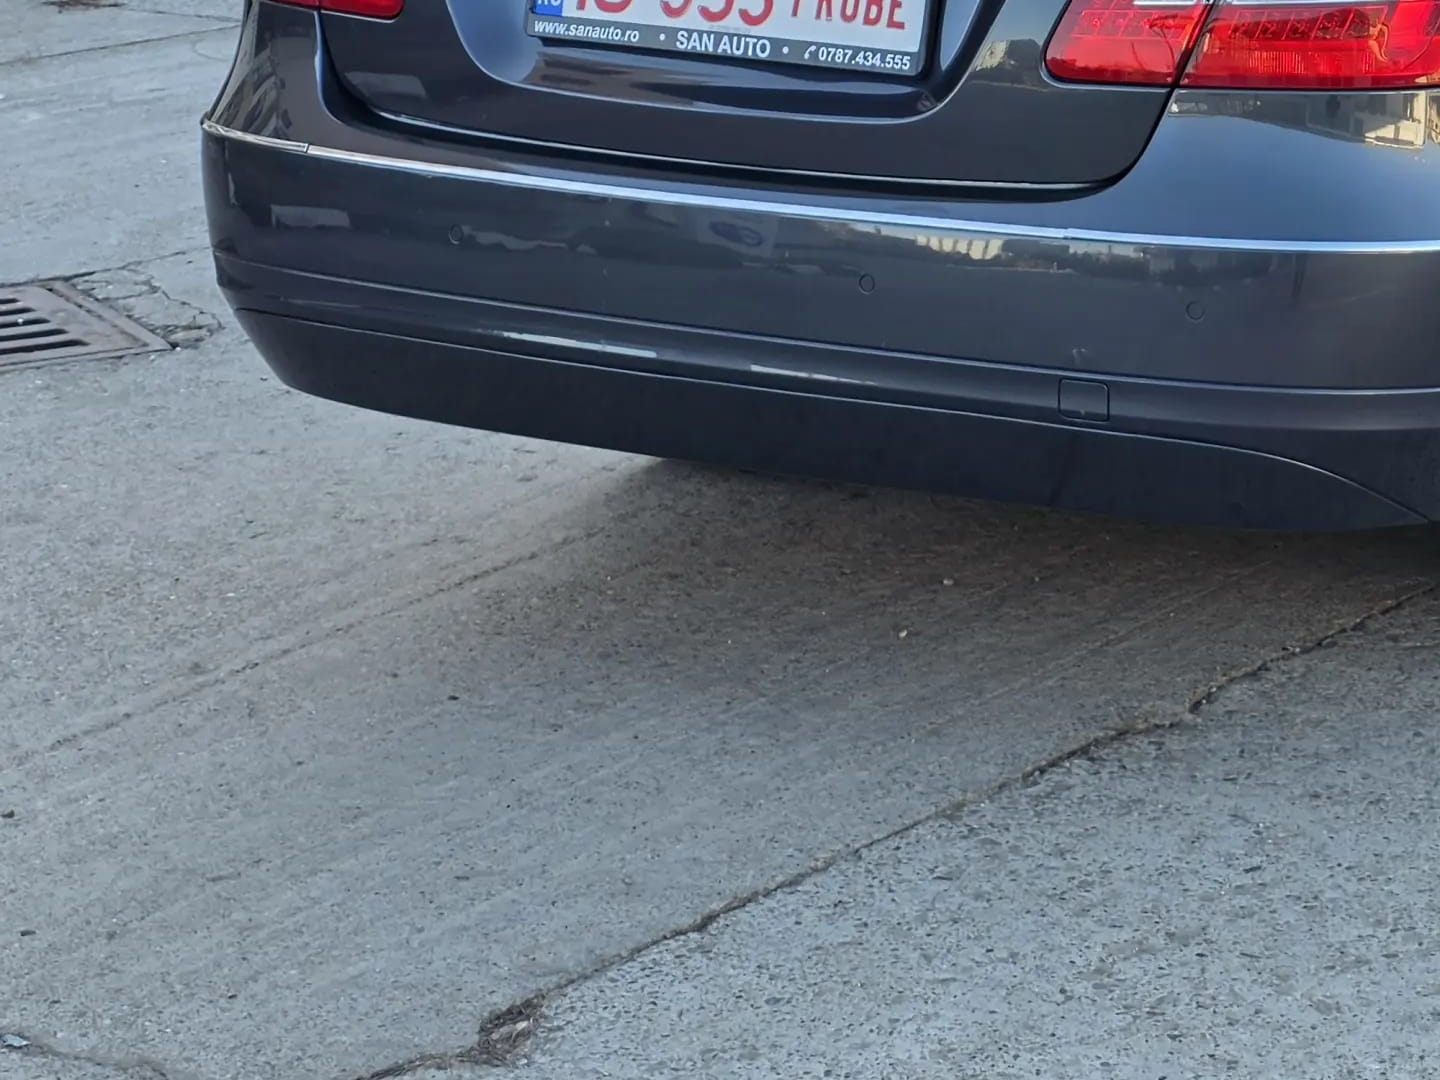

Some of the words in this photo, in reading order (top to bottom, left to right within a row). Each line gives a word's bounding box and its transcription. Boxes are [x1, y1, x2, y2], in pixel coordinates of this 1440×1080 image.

[534, 21, 639, 42] www.sanauto.ro
[676, 30, 714, 52] SAN
[718, 34, 771, 58] AUTO
[818, 46, 911, 70] 0787.434.555
